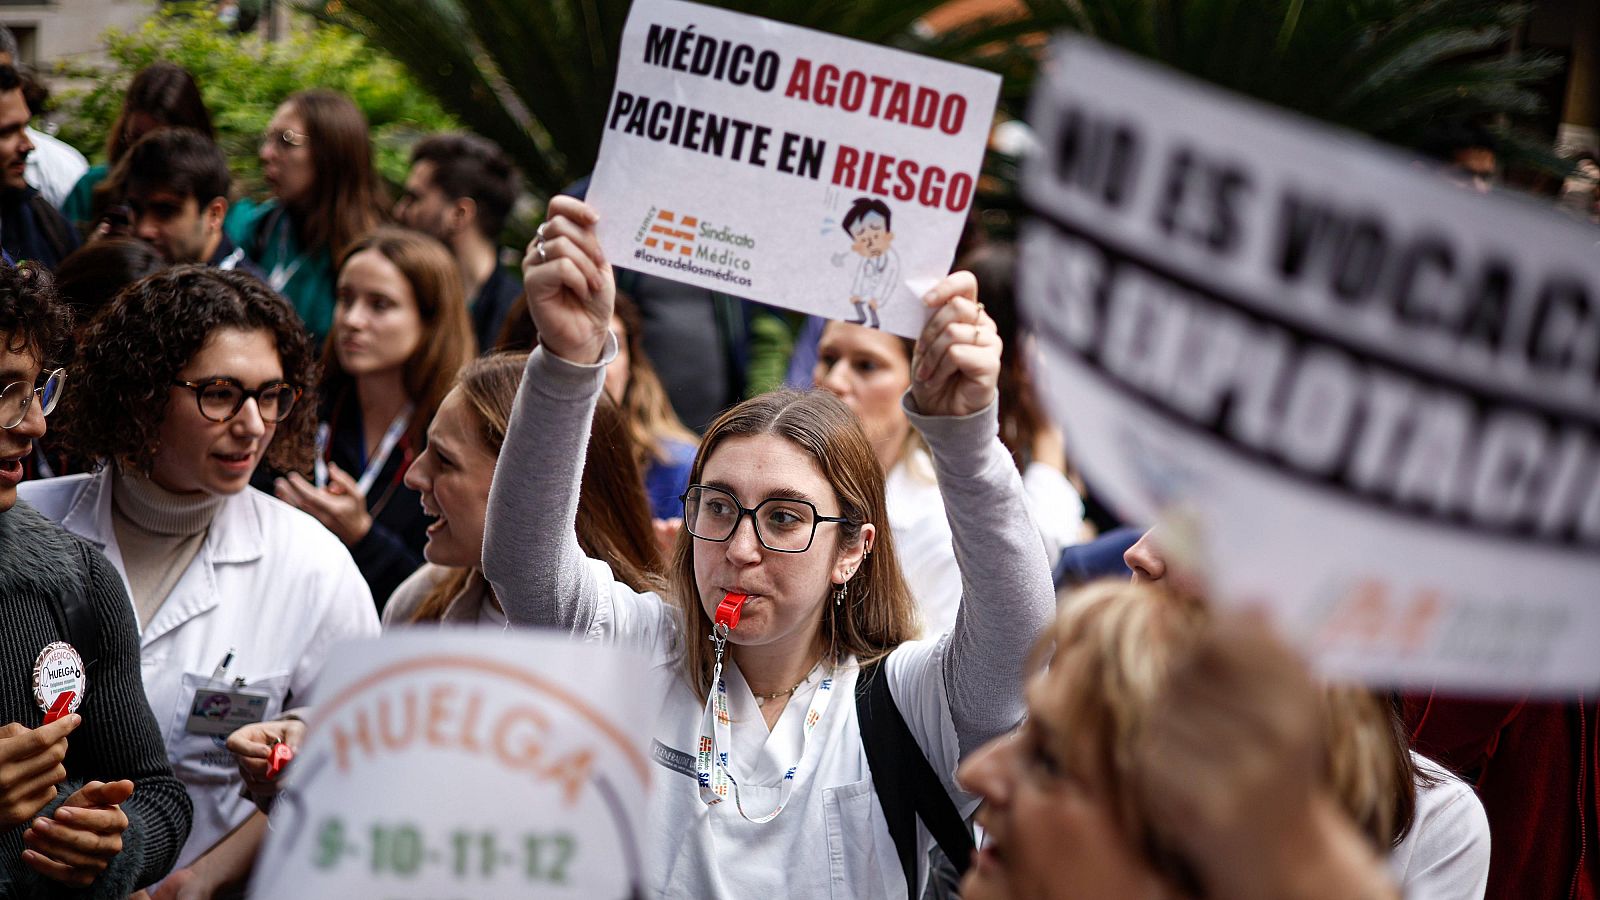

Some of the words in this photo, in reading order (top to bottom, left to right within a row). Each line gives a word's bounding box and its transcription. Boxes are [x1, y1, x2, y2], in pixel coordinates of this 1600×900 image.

[644, 24, 780, 92] MÉDICO
[785, 58, 968, 136] AGOTADO
[608, 91, 771, 166] PACIENTE
[776, 132, 826, 180] EN
[831, 144, 973, 213] RIESGO
[699, 220, 755, 249] Sindicato
[1055, 108, 1141, 211] NO
[1156, 145, 1256, 253] ES
[1273, 186, 1600, 385] VOCAC
[633, 247, 752, 287] #lavozdelosmédicos
[695, 243, 751, 271] Médico
[49, 650, 71, 665] MÉDICO
[49, 665, 75, 680] HUELGA
[332, 681, 597, 807] HUELGA
[698, 771, 709, 788] SAE
